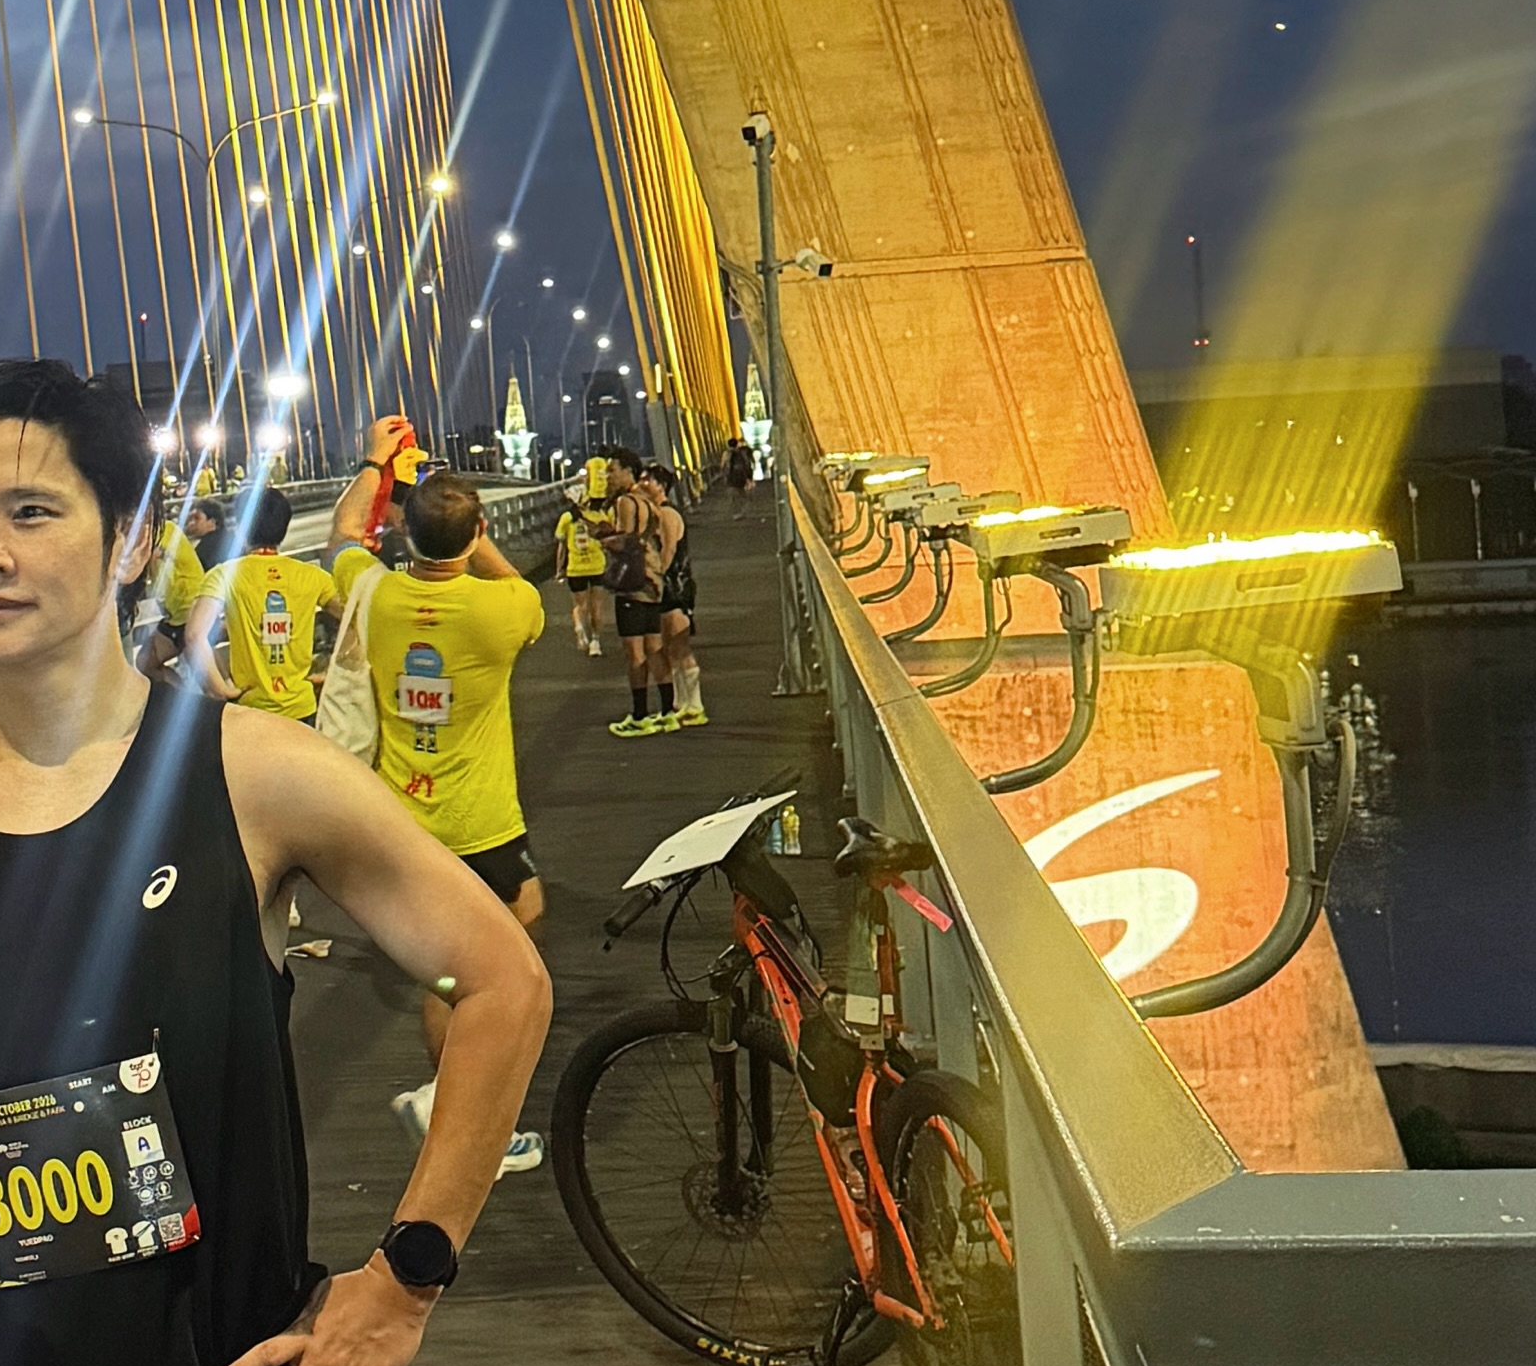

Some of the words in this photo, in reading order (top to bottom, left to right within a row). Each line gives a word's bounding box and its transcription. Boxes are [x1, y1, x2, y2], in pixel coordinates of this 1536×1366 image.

[267, 621, 287, 634] 10K
[406, 689, 443, 710] 10K
[123, 1115, 152, 1130] BLOCK
[137, 1136, 150, 1151] A
